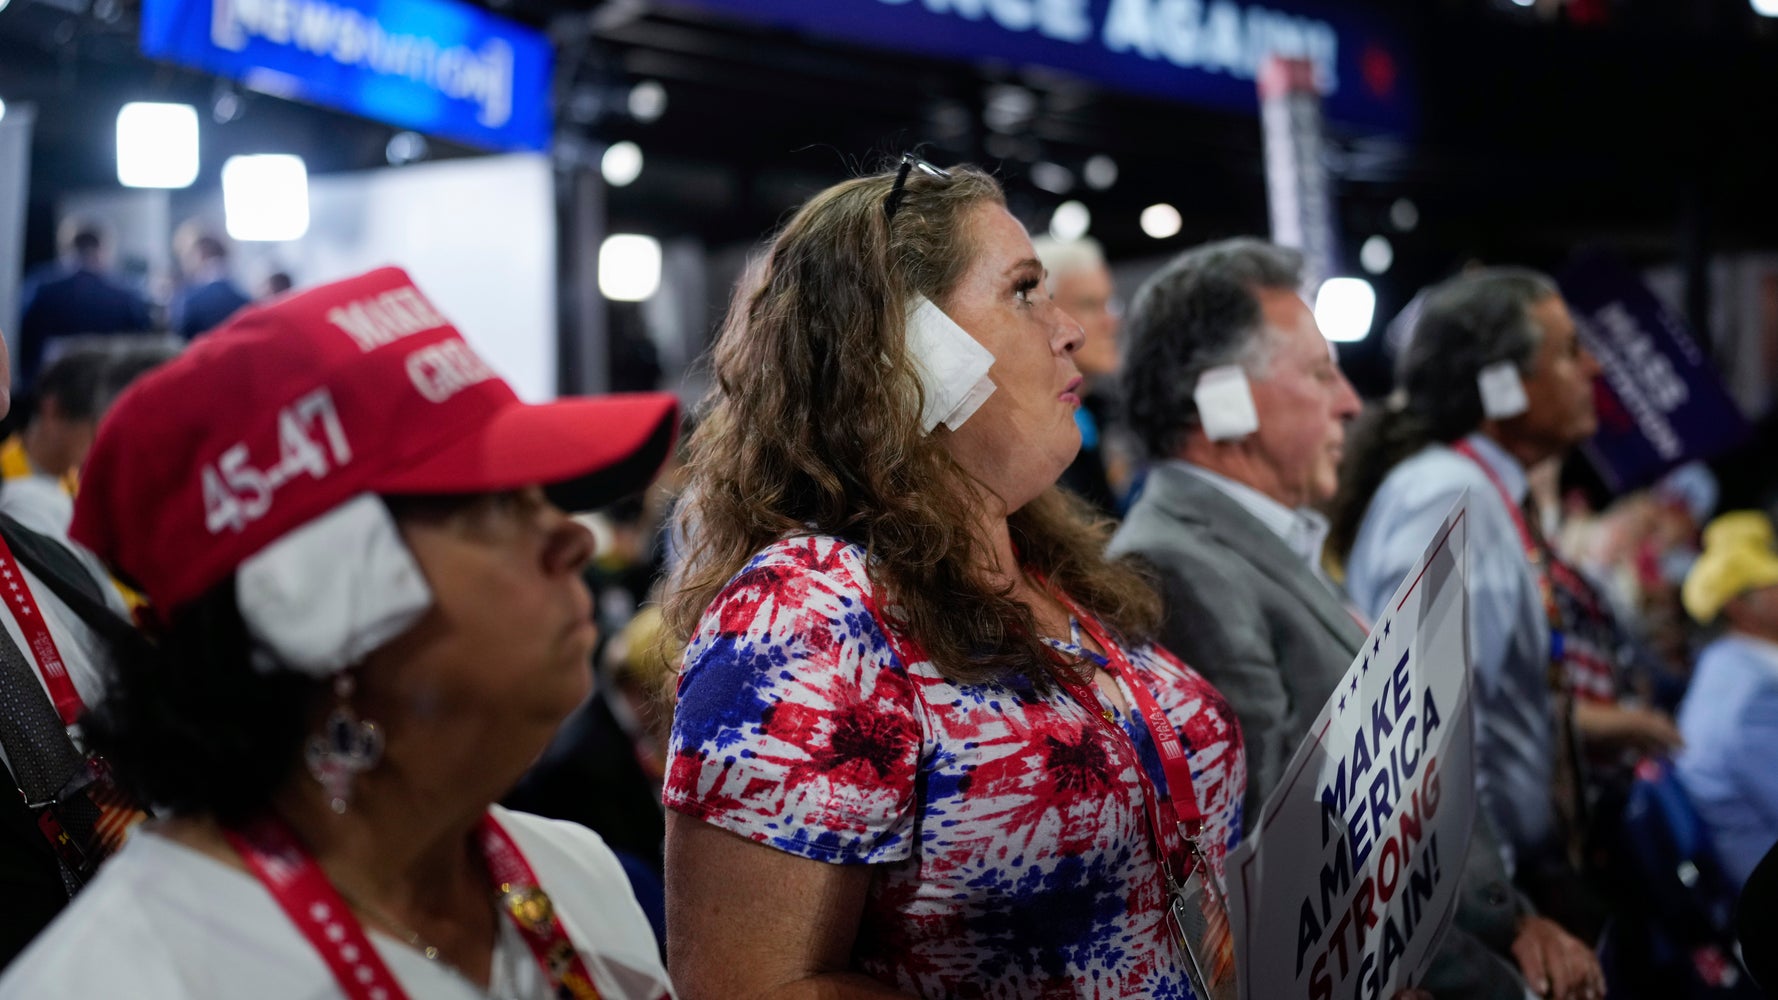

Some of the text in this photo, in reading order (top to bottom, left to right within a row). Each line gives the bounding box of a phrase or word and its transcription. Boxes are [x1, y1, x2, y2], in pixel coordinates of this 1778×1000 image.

[201, 385, 351, 534] 45-47
[1296, 686, 1441, 980] AMERICA
[1322, 648, 1411, 850] MAKE
[1309, 756, 1441, 1000] STRONG
[1354, 831, 1441, 1000] GAIN!
